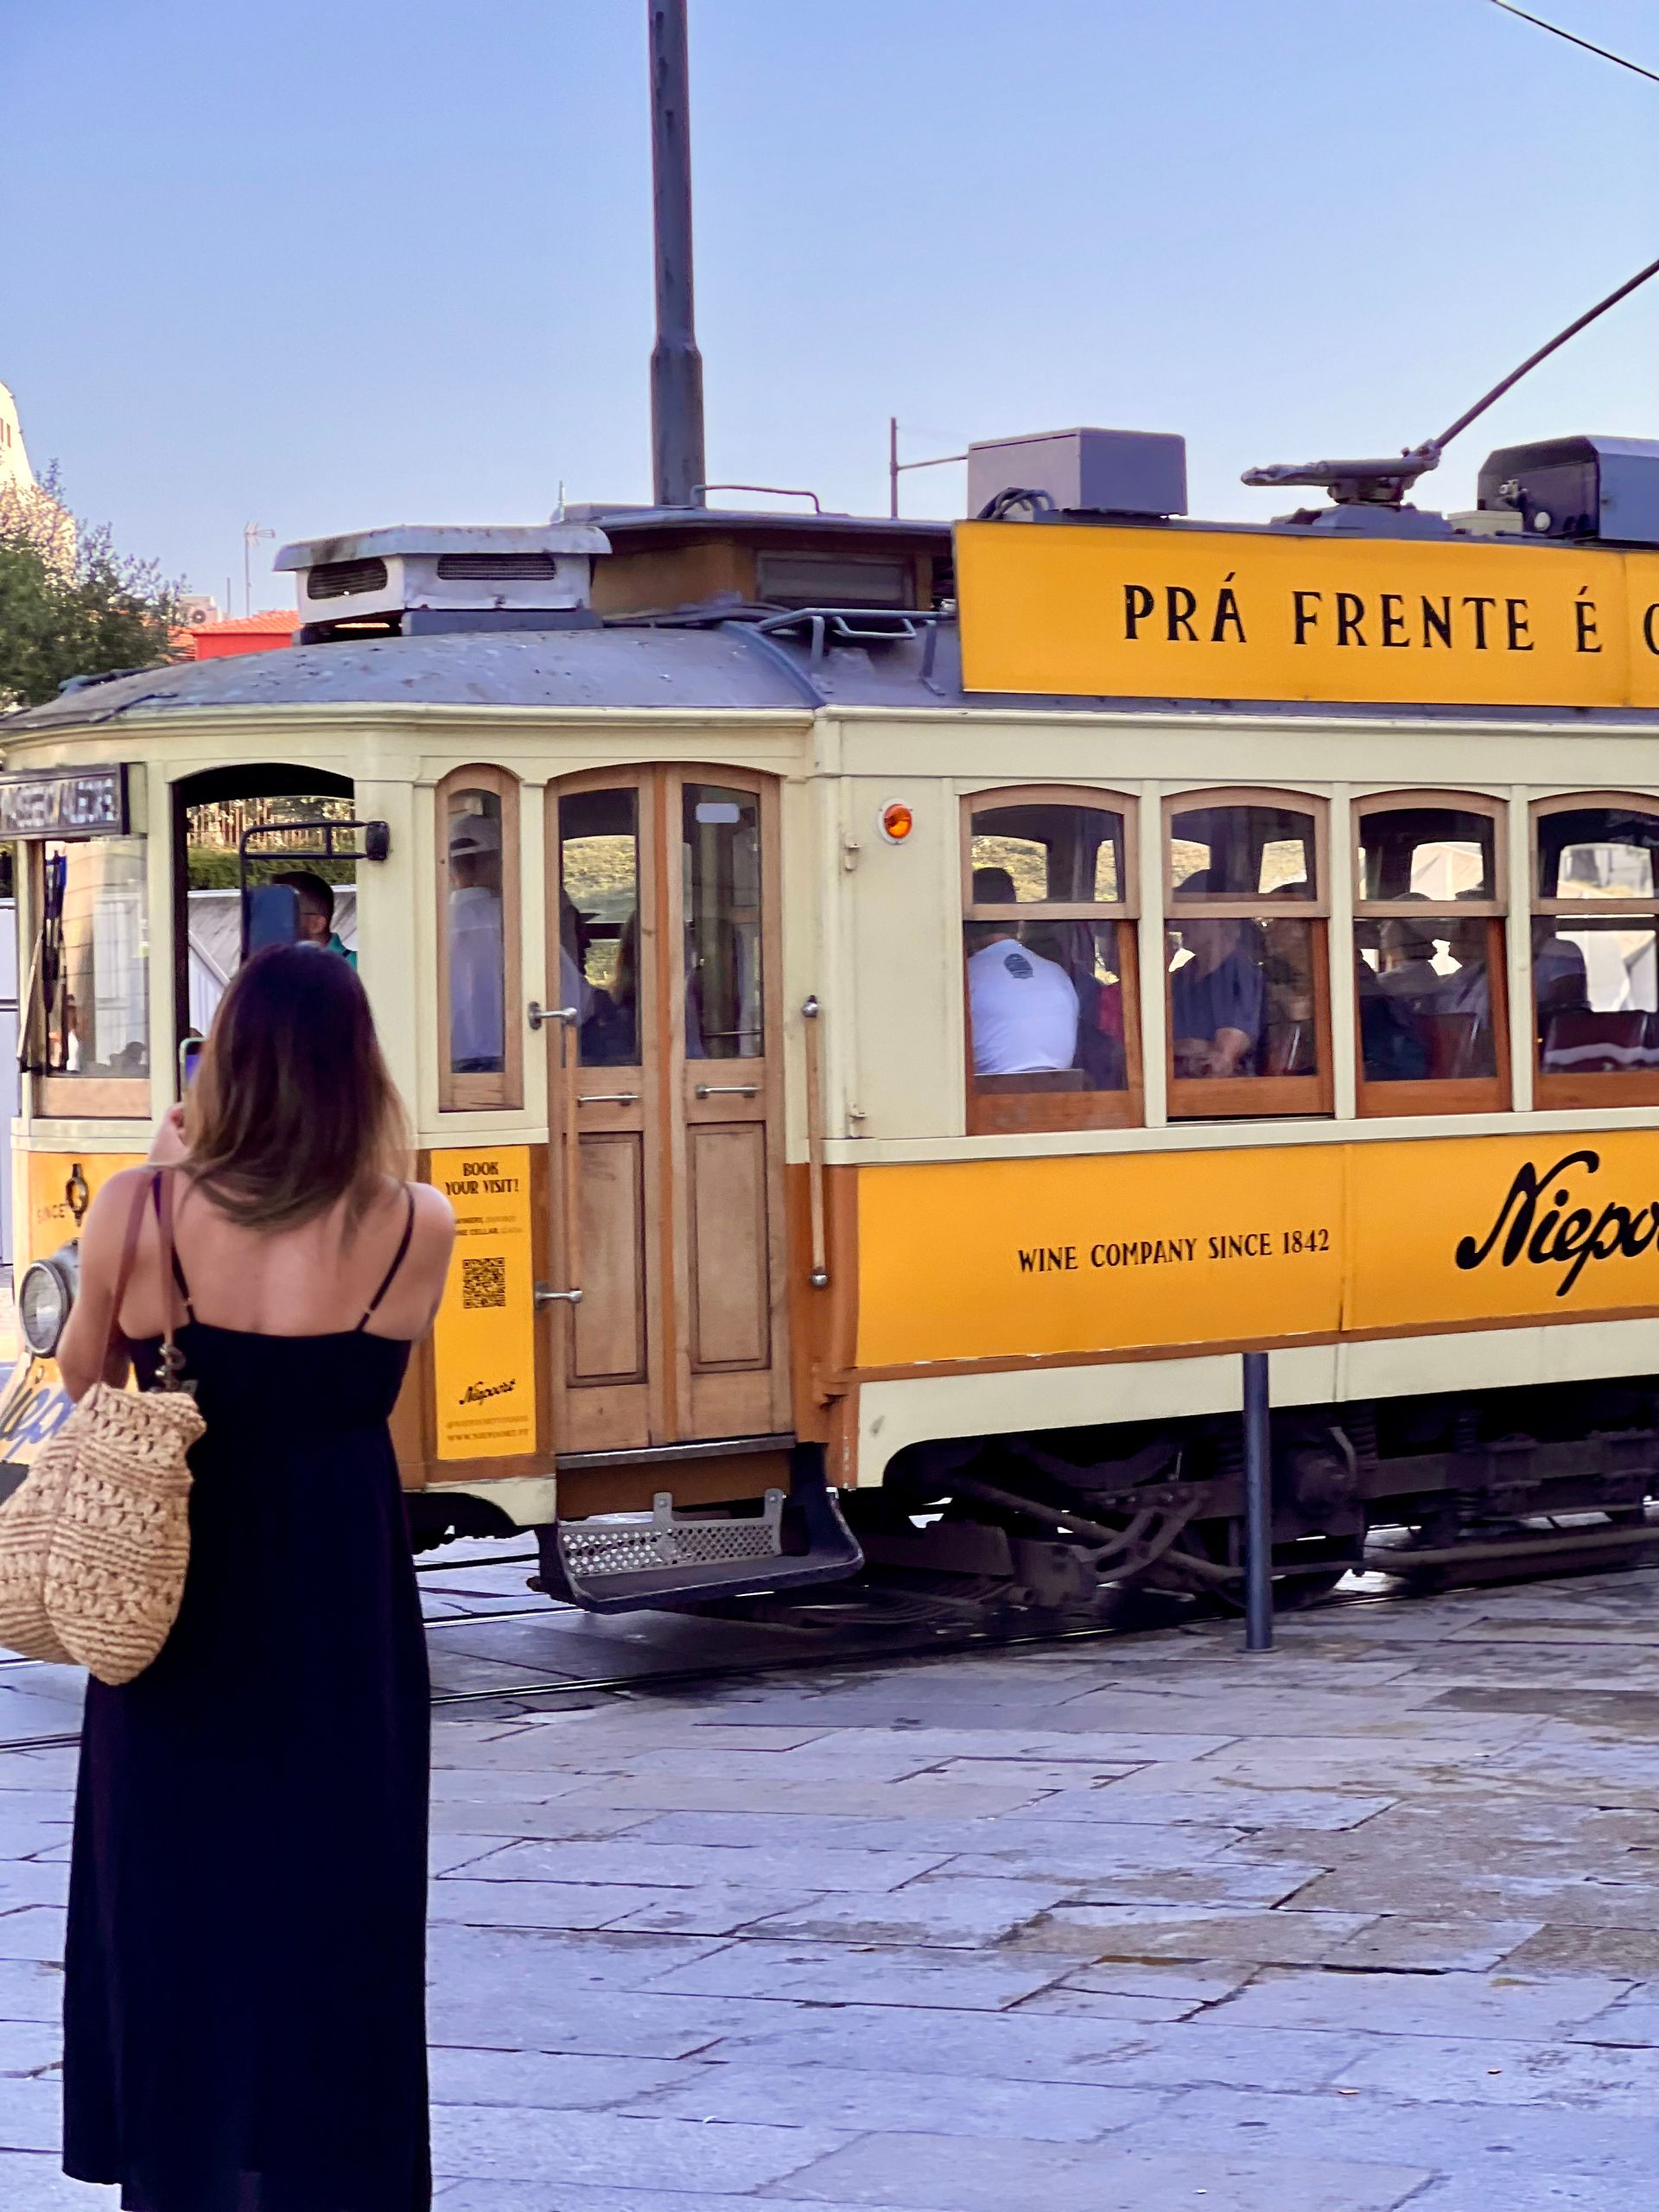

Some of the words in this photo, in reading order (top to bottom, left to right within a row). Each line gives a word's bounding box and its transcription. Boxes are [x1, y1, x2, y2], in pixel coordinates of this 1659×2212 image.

[1123, 571, 1248, 643] PRÁ
[1292, 590, 1535, 651] FRENTE
[1573, 585, 1603, 653] É
[444, 1180, 480, 1196] YOUR
[483, 1178, 519, 1193] VISIT!
[462, 1161, 499, 1177] BOOK
[1455, 1149, 1659, 1297] Niepo
[1017, 1246, 1078, 1273] WINE
[1090, 1237, 1198, 1268] COMPANY
[1208, 1233, 1273, 1259] SINCE
[1281, 1228, 1331, 1255] 1842
